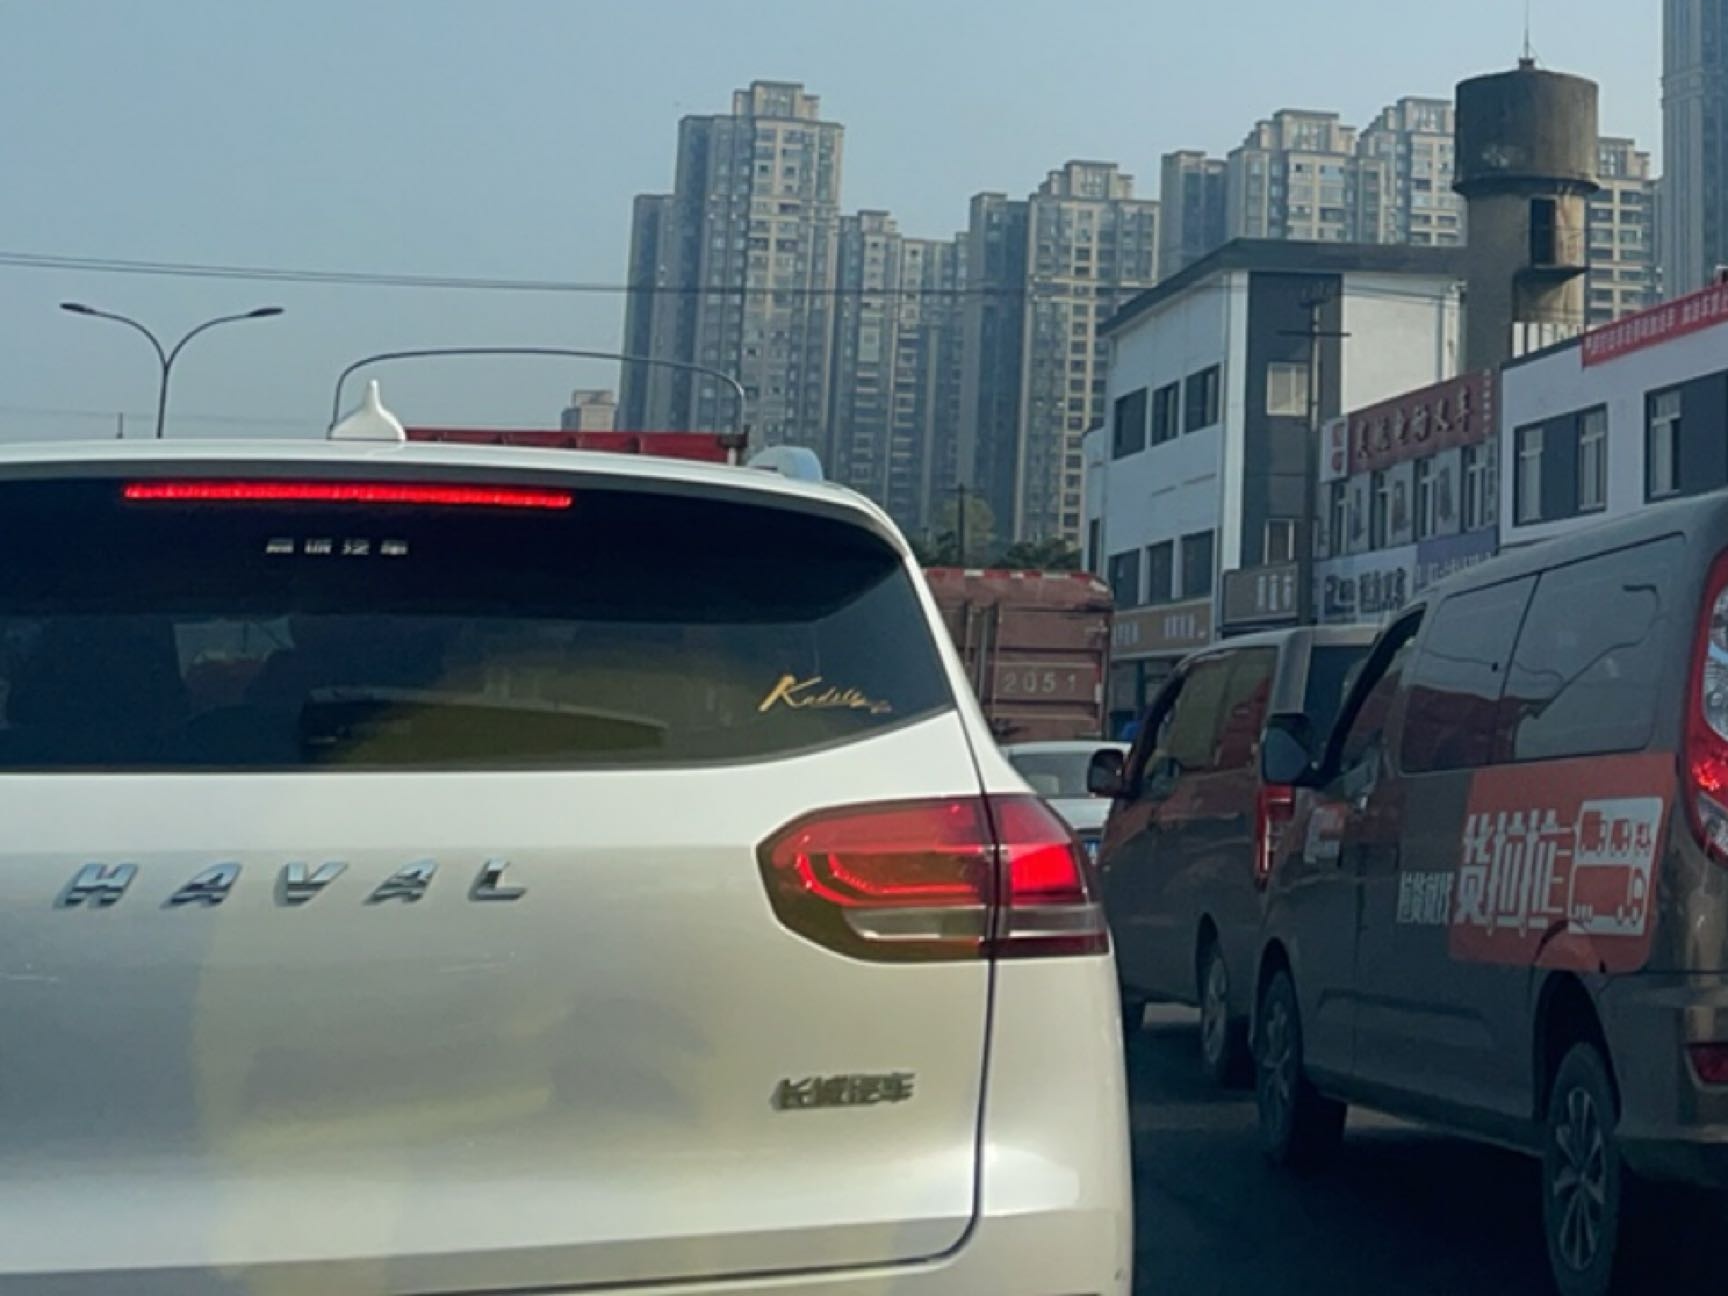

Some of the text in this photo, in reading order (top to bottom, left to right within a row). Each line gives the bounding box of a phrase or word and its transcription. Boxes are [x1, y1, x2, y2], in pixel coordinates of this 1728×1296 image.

[1003, 672, 1077, 694] 2051
[63, 859, 527, 906] HAVAL
[1454, 809, 1564, 936] 货拉拉
